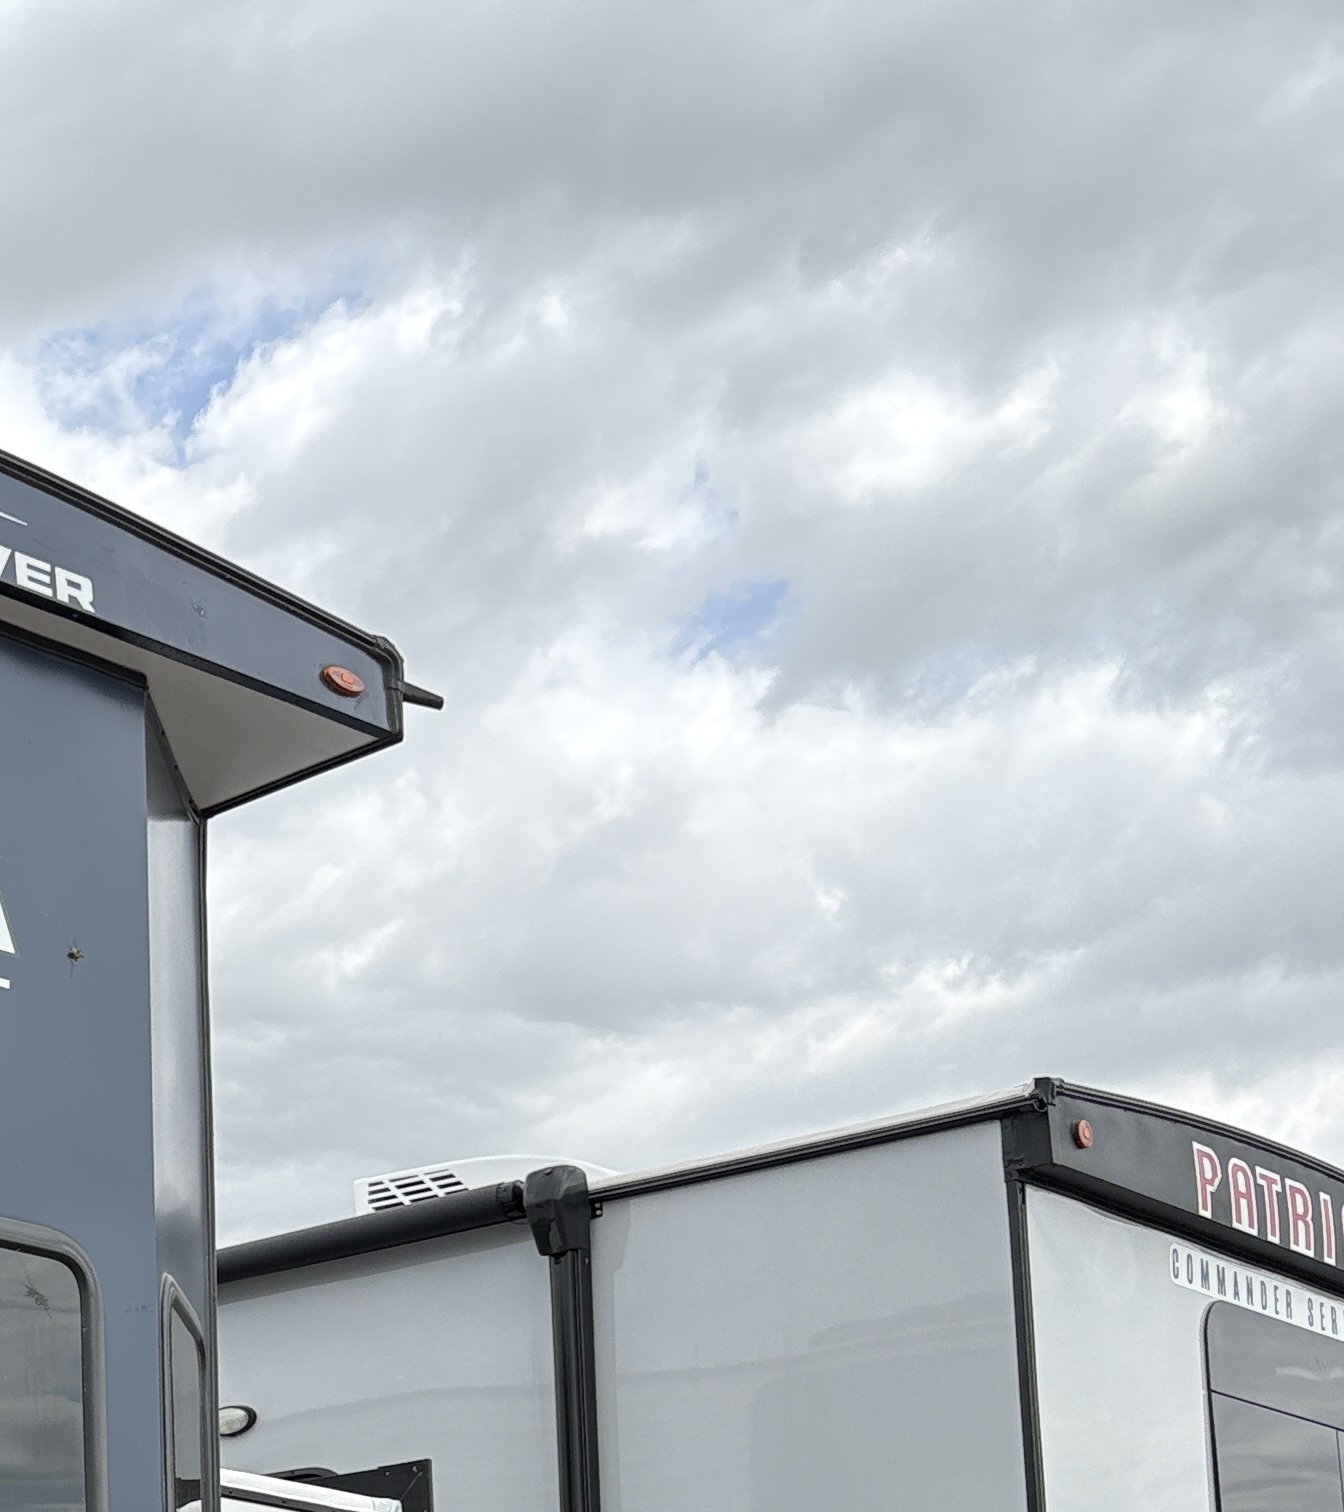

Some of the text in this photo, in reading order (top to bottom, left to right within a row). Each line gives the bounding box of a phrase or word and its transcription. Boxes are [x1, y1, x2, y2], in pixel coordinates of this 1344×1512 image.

[1191, 1140, 1344, 1267] PATRI
[1173, 1248, 1344, 1336] COMMANDER SER
